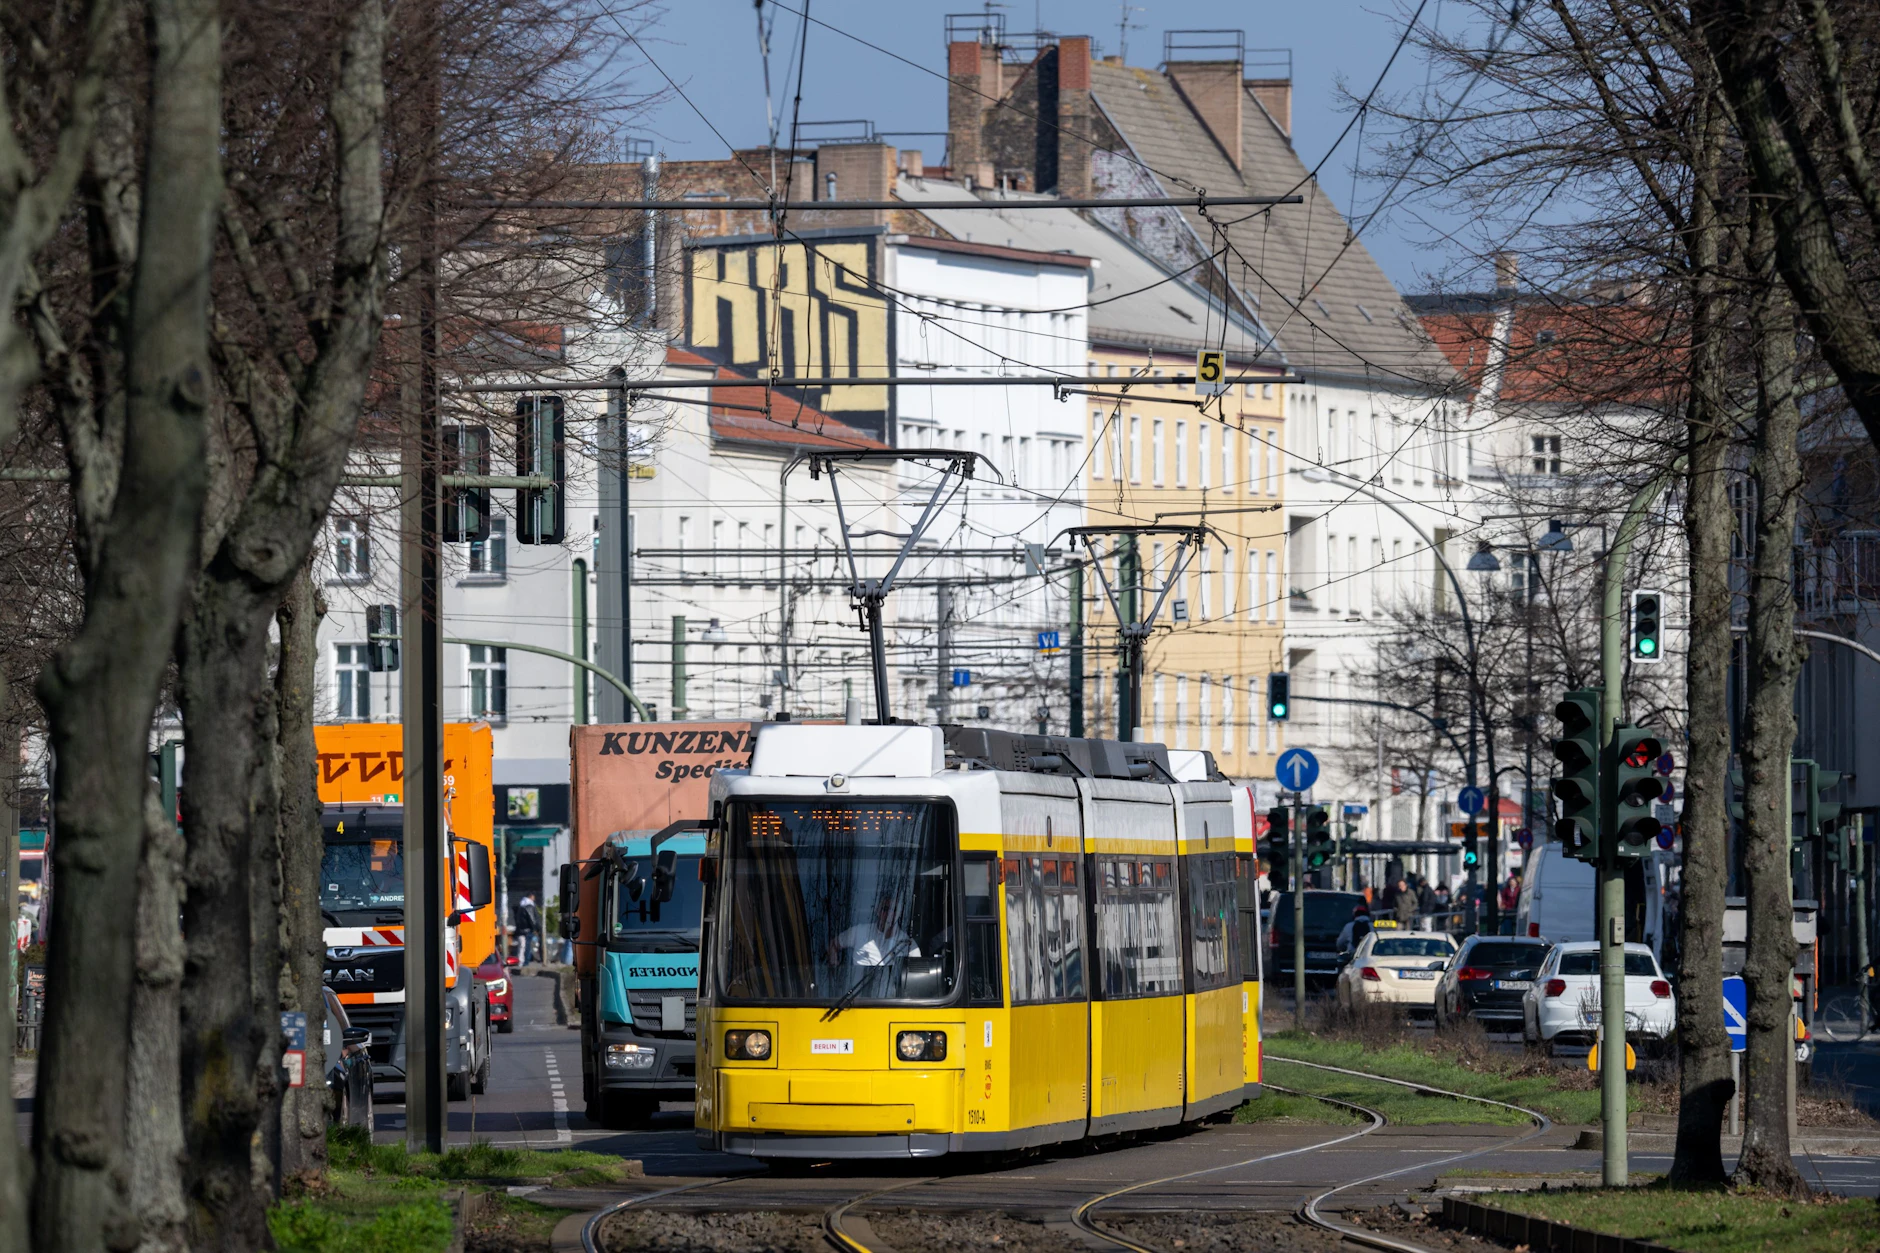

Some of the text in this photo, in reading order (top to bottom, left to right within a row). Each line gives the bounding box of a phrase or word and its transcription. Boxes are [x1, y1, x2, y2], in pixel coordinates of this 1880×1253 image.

[1200, 353, 1220, 382] 5
[1173, 601, 1187, 620] E
[1041, 633, 1055, 647] W
[336, 821, 344, 834] 4
